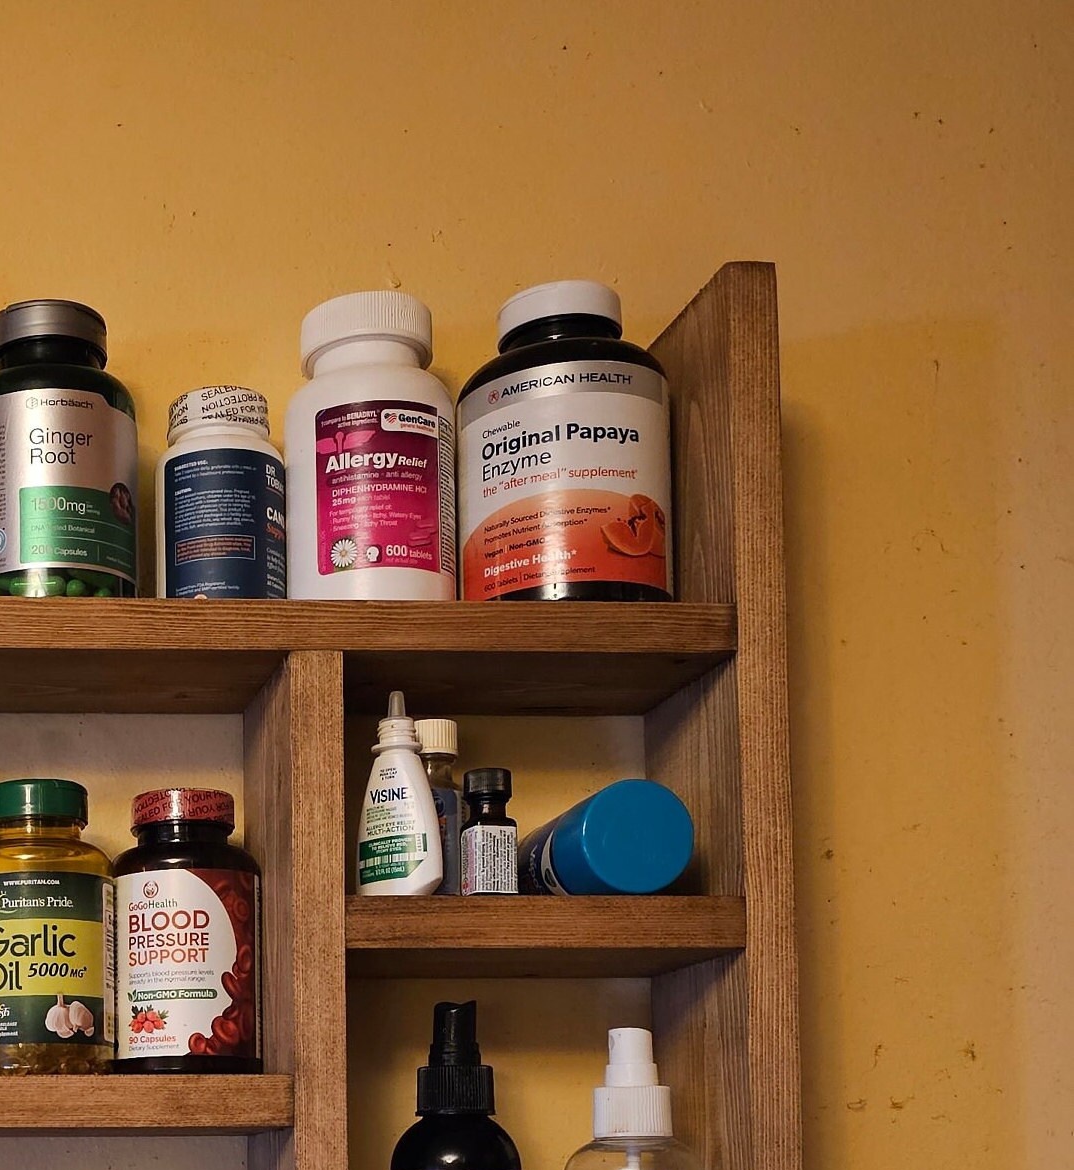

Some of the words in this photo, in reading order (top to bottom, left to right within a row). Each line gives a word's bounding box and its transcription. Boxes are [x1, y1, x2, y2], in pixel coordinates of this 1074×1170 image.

[501, 374, 574, 398] AMERICAN
[580, 372, 631, 384] HEALTH
[399, 413, 435, 428] GenCare
[482, 420, 520, 439] Chewable
[29, 428, 93, 449] Ginger
[482, 425, 560, 461] Original
[567, 423, 639, 444] Papaya
[30, 448, 76, 465] Root
[326, 452, 398, 474] Allergy
[398, 457, 427, 468] Relief
[482, 451, 551, 482] Enzyme
[332, 483, 414, 497] DIPHENHYDRAMINE
[386, 545, 407, 556] 600
[410, 550, 432, 560] tablets
[370, 787, 408, 804] VISINE
[2, 896, 45, 908] Puritan's
[128, 899, 177, 911] GoGoHealth
[128, 910, 209, 934] BLOOD
[128, 933, 209, 950] PRESSURE
[128, 948, 209, 967] SUPPORT
[28, 963, 69, 977] 5000
[138, 991, 177, 1000] Non-GMO
[178, 990, 213, 999] Formula
